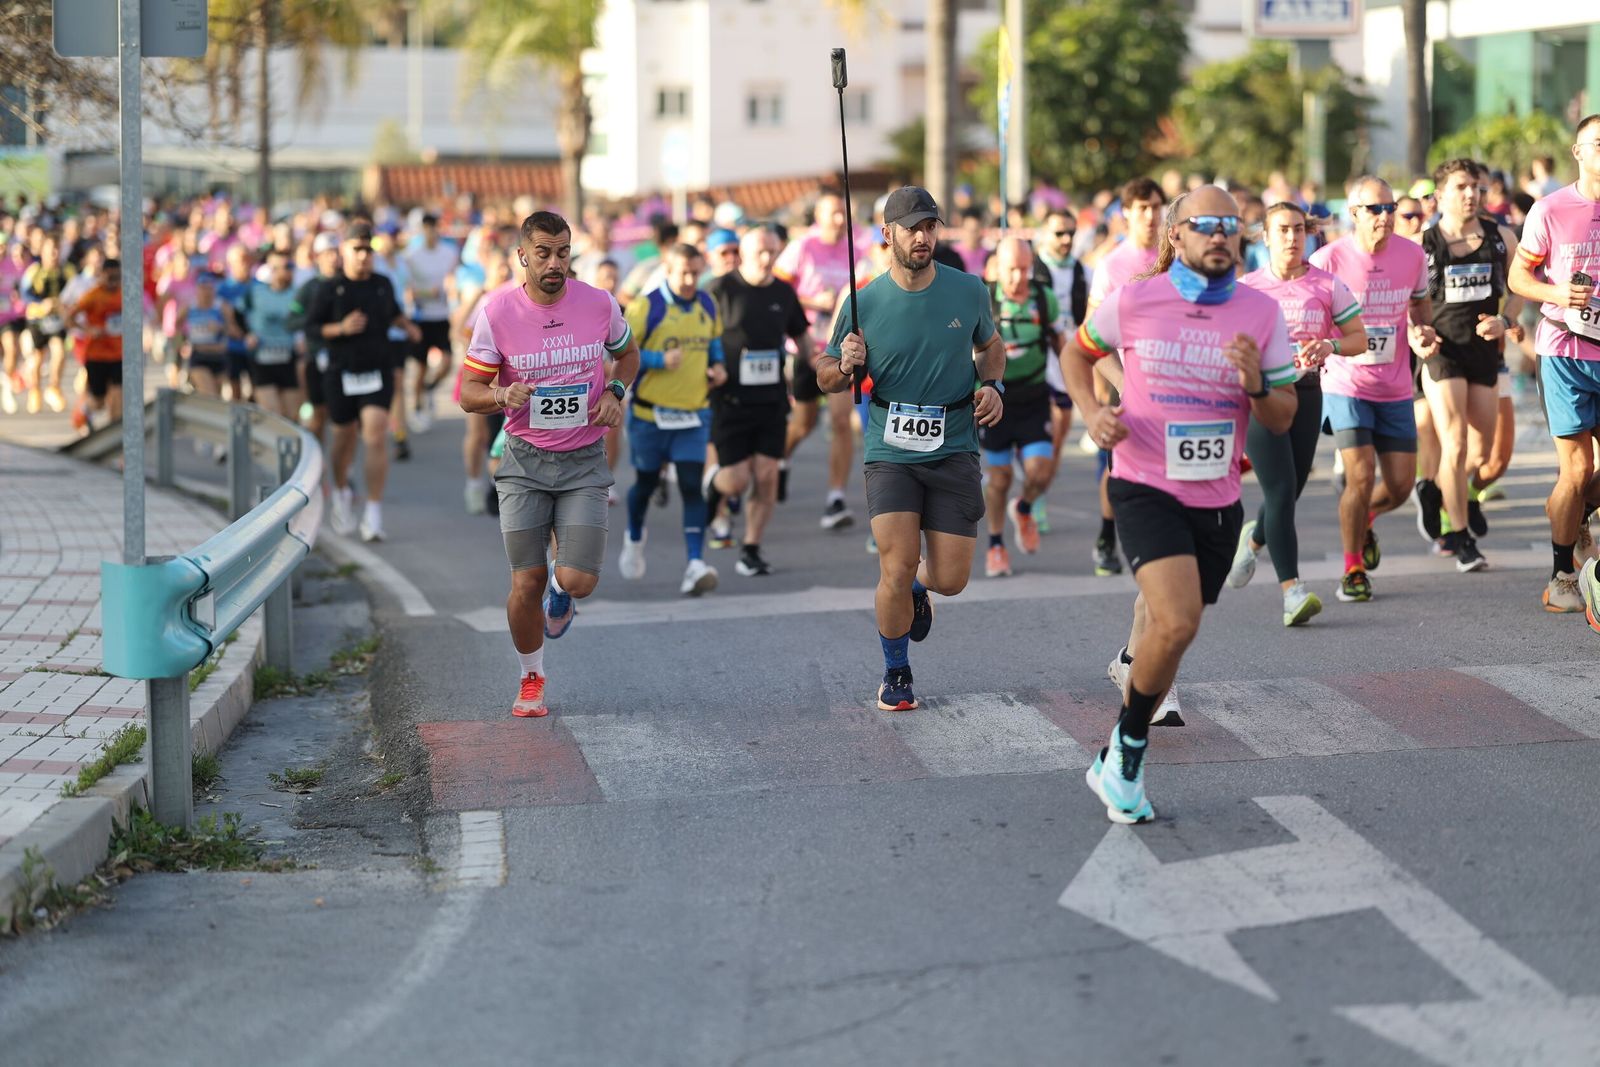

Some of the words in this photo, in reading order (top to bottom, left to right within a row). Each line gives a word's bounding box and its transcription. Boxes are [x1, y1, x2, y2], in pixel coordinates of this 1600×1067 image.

[542, 334, 574, 350] XXXVI
[1178, 328, 1220, 345] XXXVI
[1134, 338, 1181, 361] MEDIA
[508, 351, 548, 370] MEDIA
[540, 397, 579, 415] 235
[891, 416, 942, 438] 1405
[1179, 439, 1225, 460] 653
